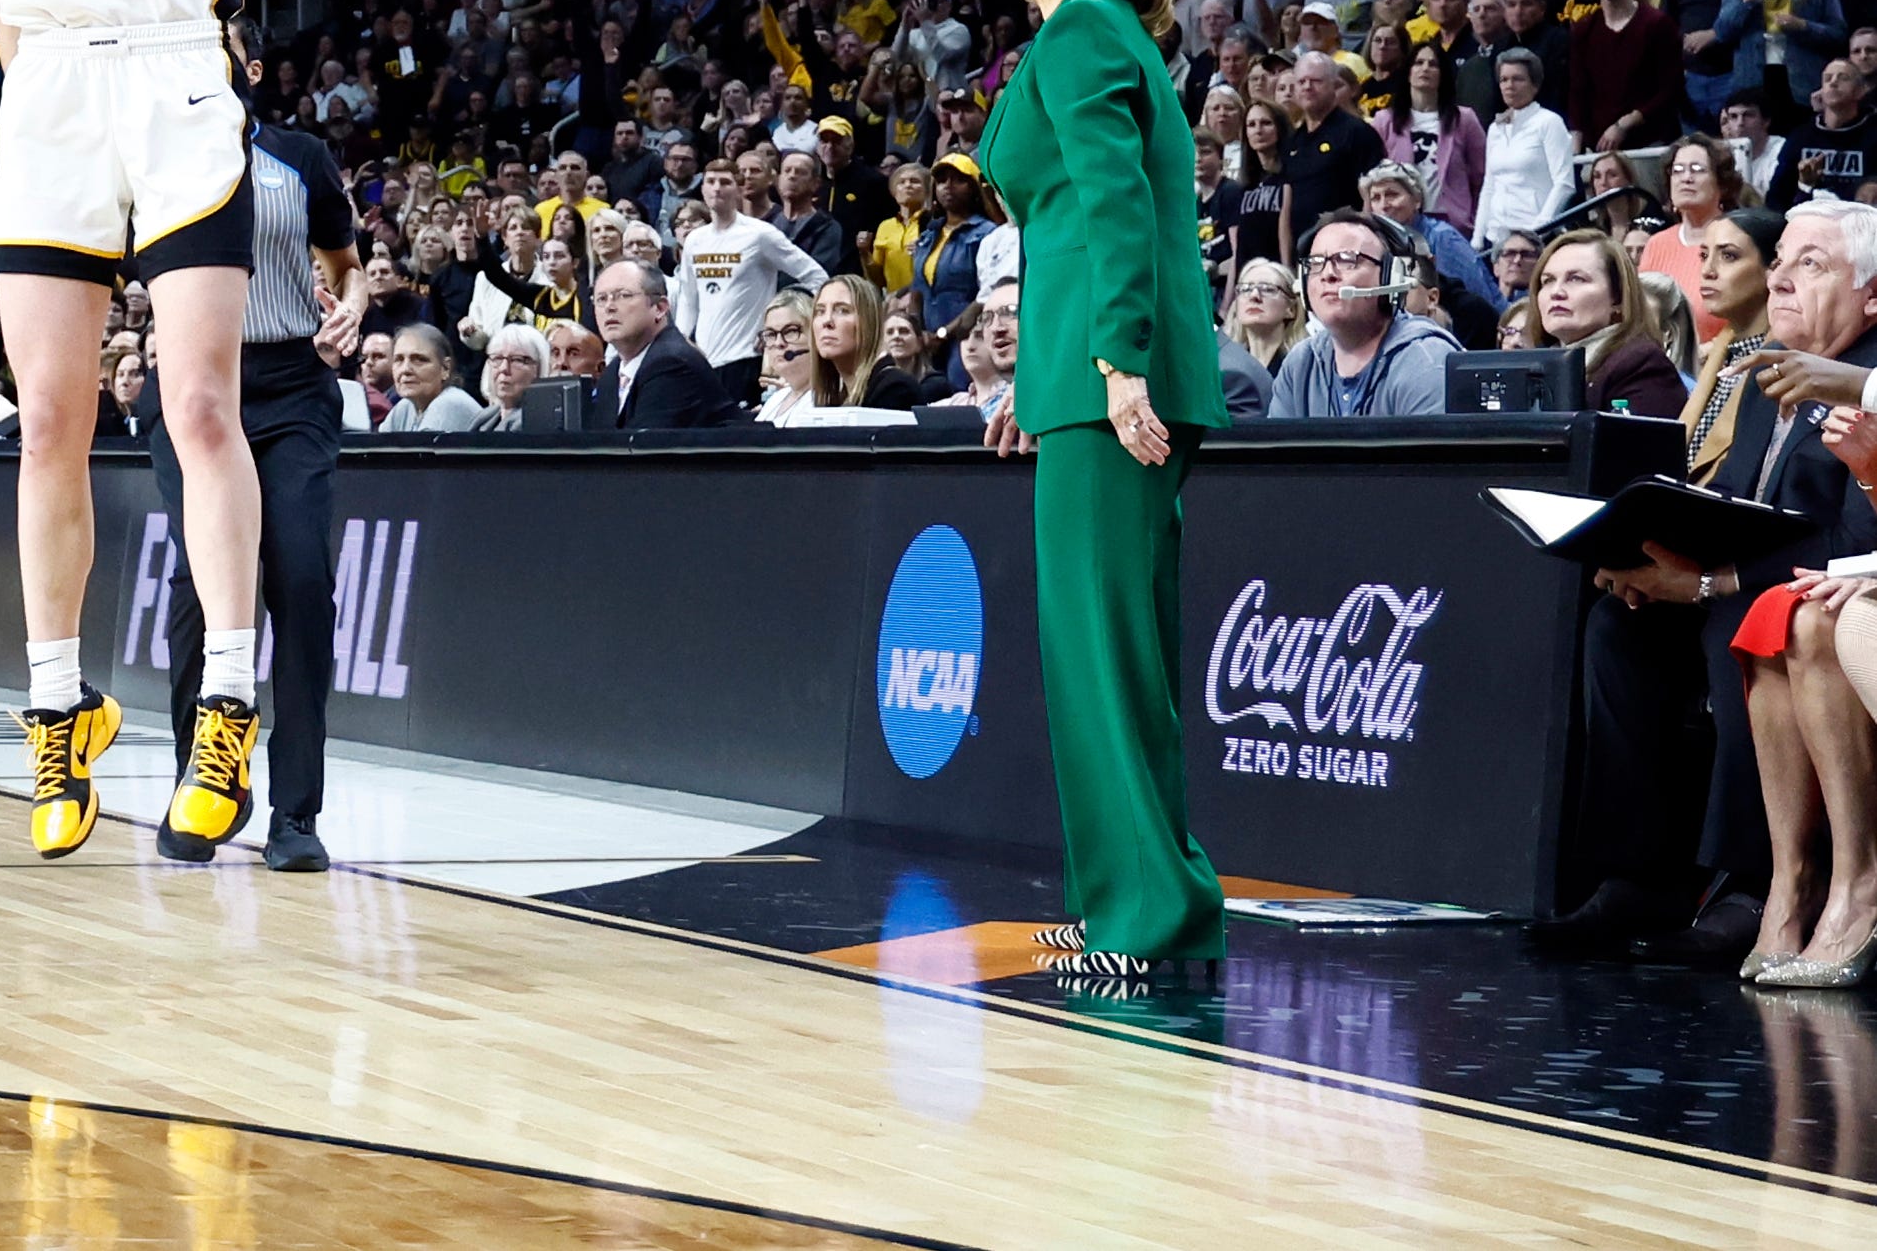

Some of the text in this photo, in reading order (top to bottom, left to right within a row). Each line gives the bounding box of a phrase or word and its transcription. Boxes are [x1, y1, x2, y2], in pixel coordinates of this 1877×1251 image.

[882, 647, 977, 716] NCAA
[1204, 578, 1444, 742] Coca-Cola
[1221, 736, 1390, 788] ZERO SUGAR
